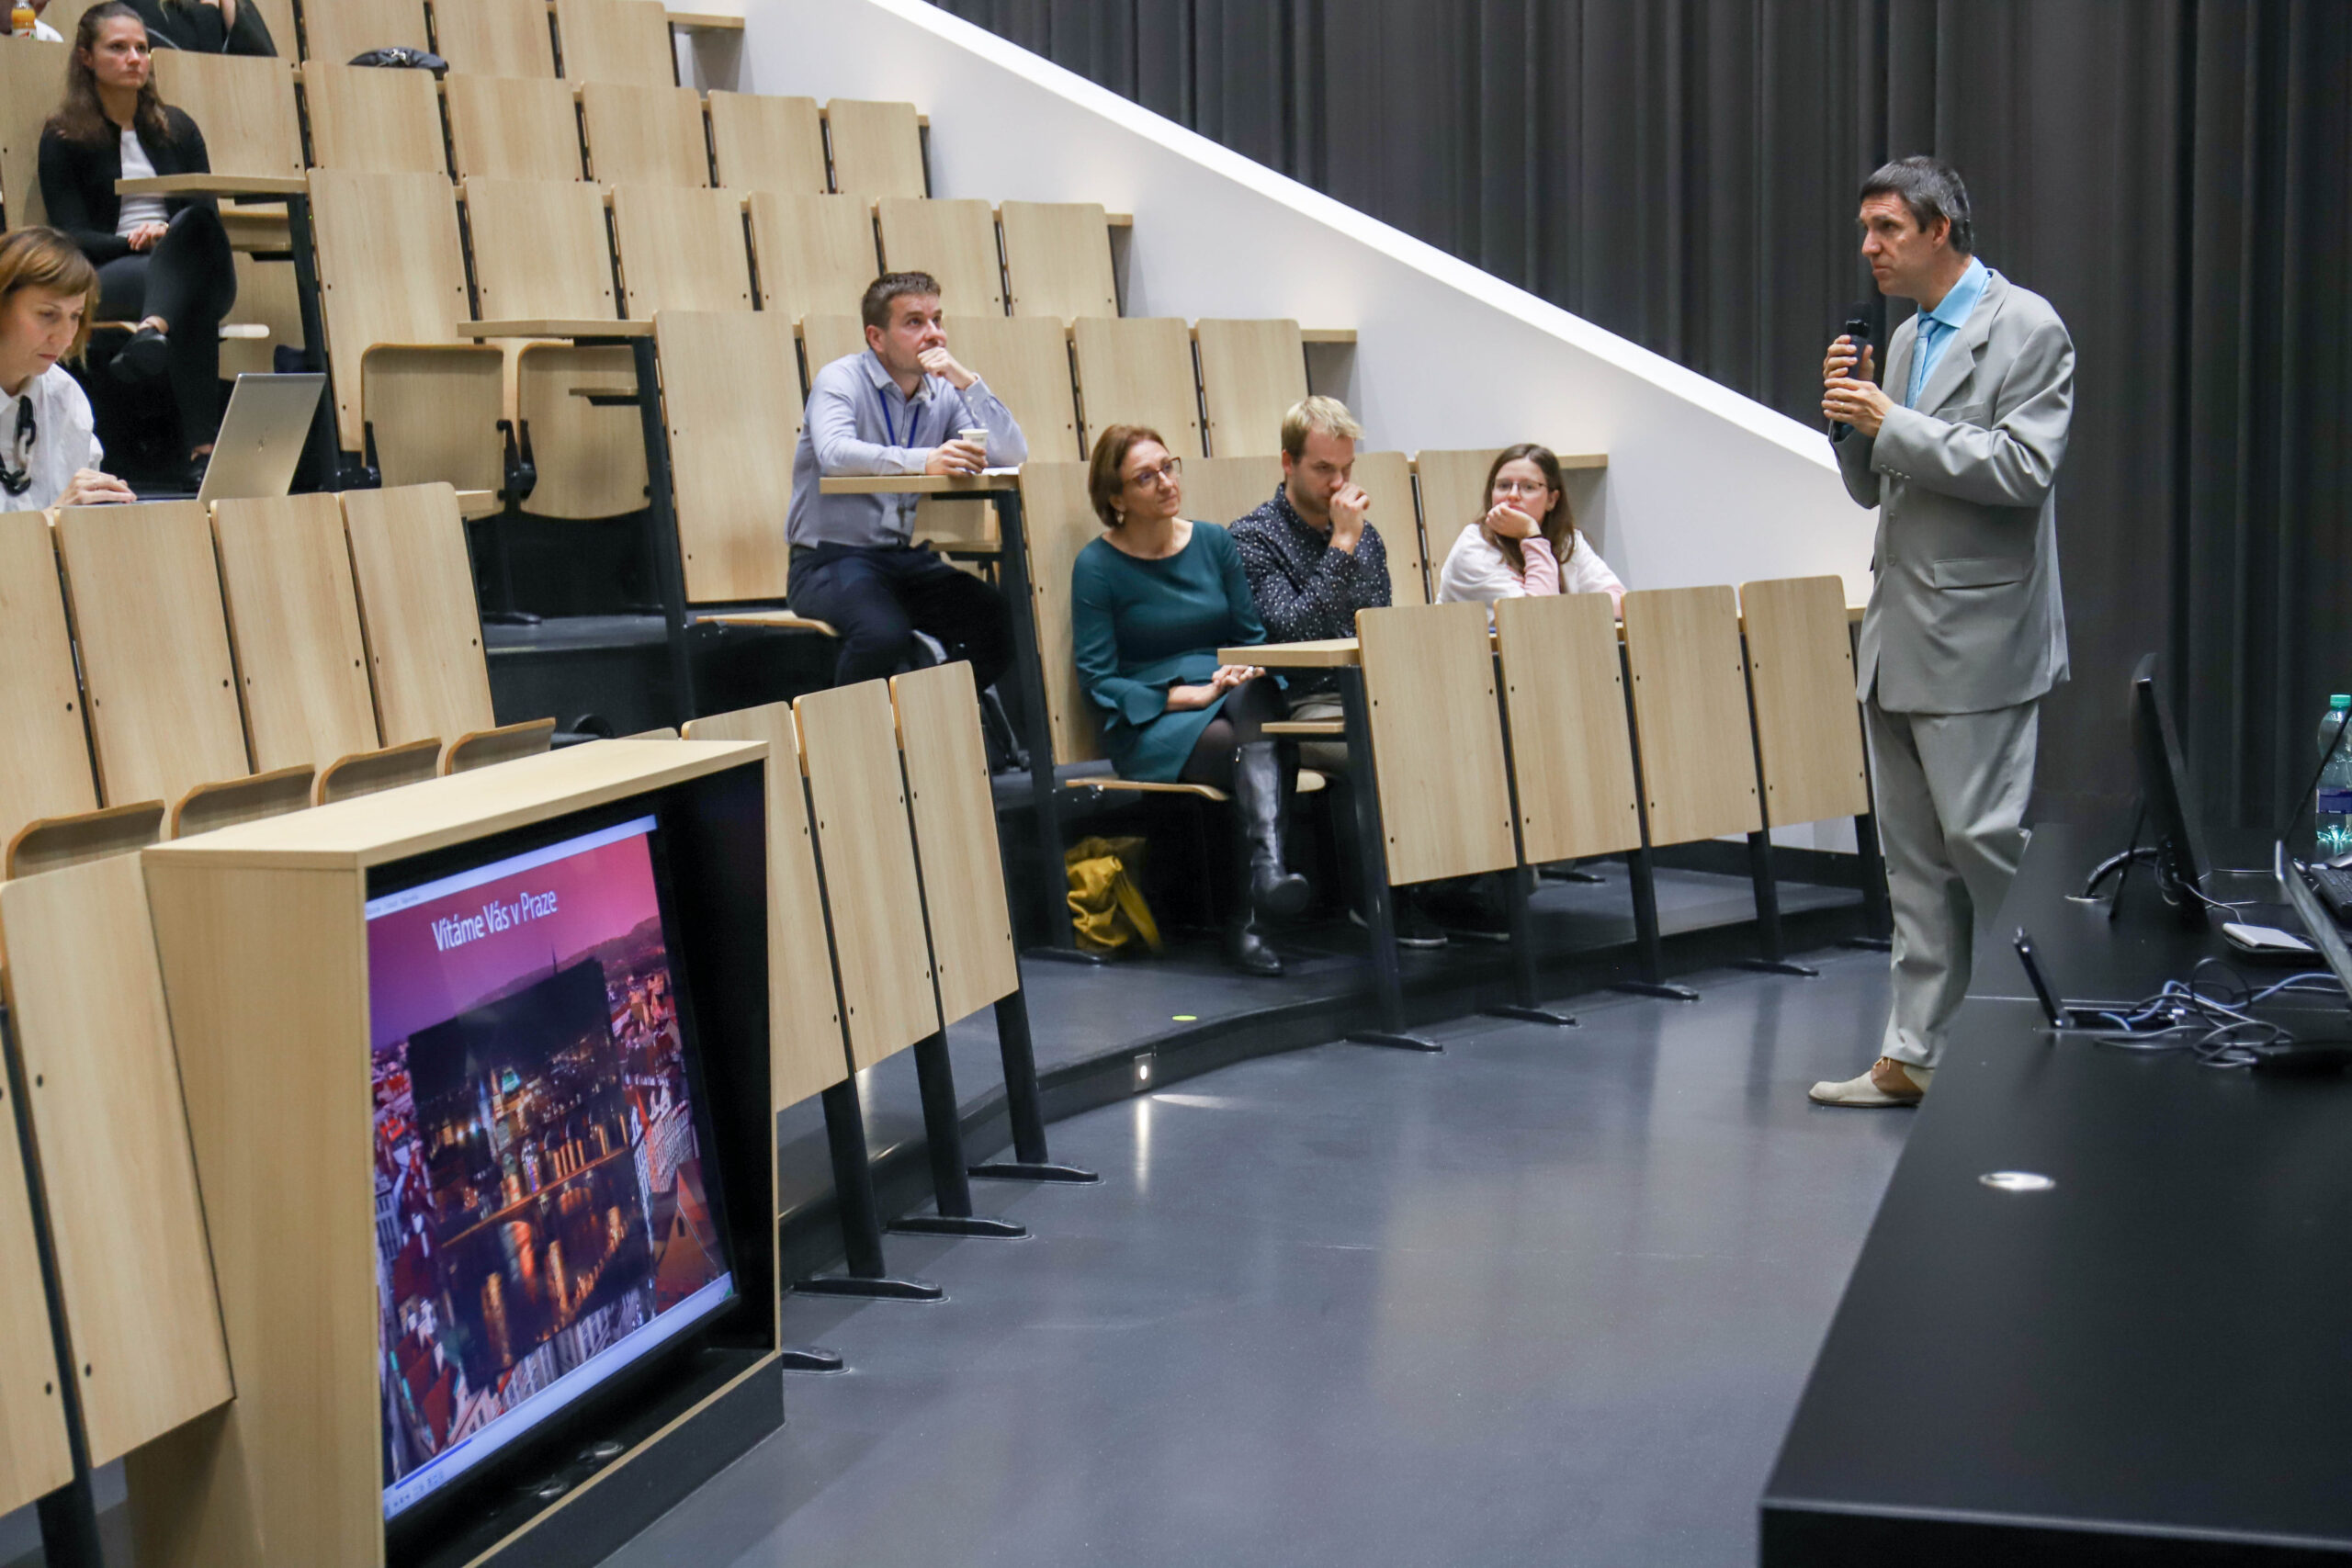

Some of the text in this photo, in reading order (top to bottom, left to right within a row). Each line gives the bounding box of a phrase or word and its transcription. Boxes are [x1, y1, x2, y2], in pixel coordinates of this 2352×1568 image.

[431, 889, 558, 952] Vítáme Vás v Praze
